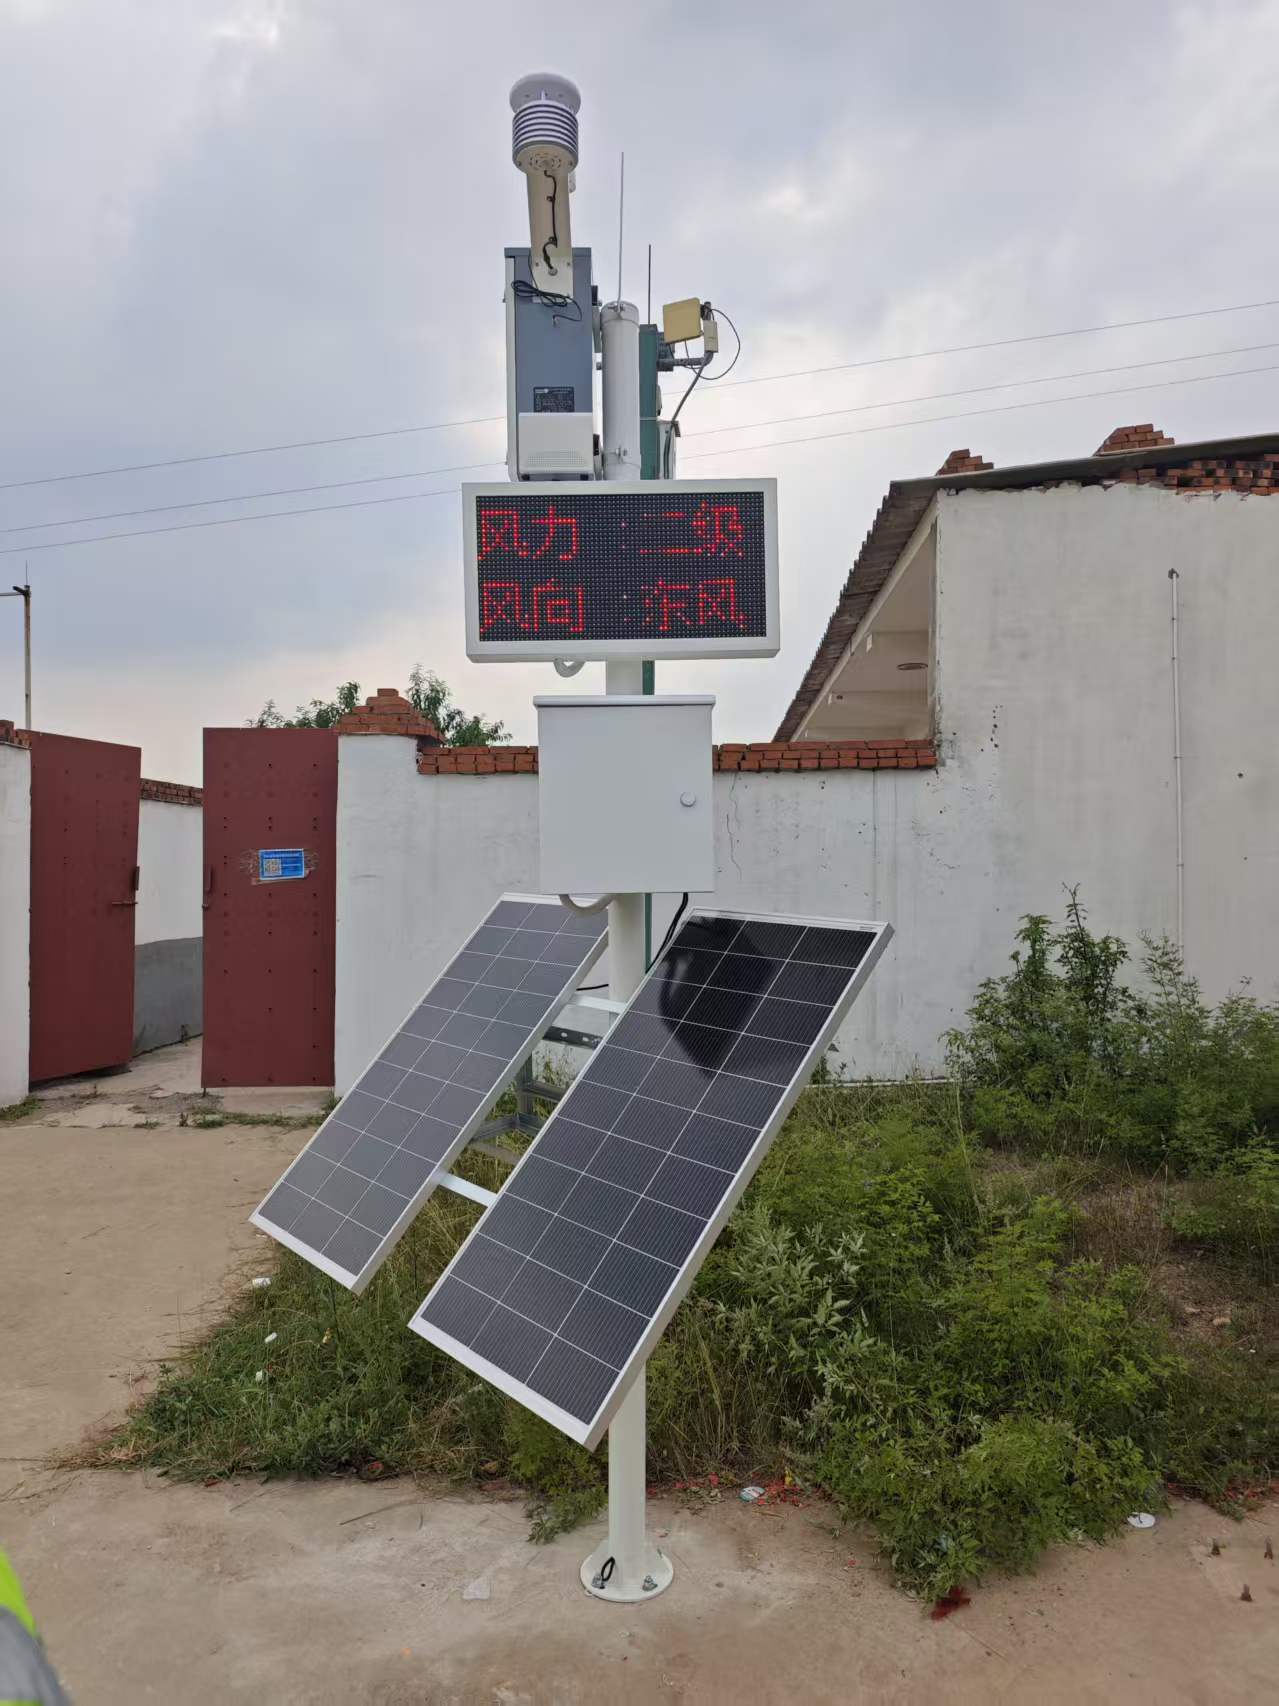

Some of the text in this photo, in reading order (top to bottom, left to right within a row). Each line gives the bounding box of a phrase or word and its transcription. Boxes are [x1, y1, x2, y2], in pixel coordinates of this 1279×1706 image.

[476, 505, 578, 560] 风力
[640, 501, 744, 557] 二级
[479, 578, 584, 632] 风向
